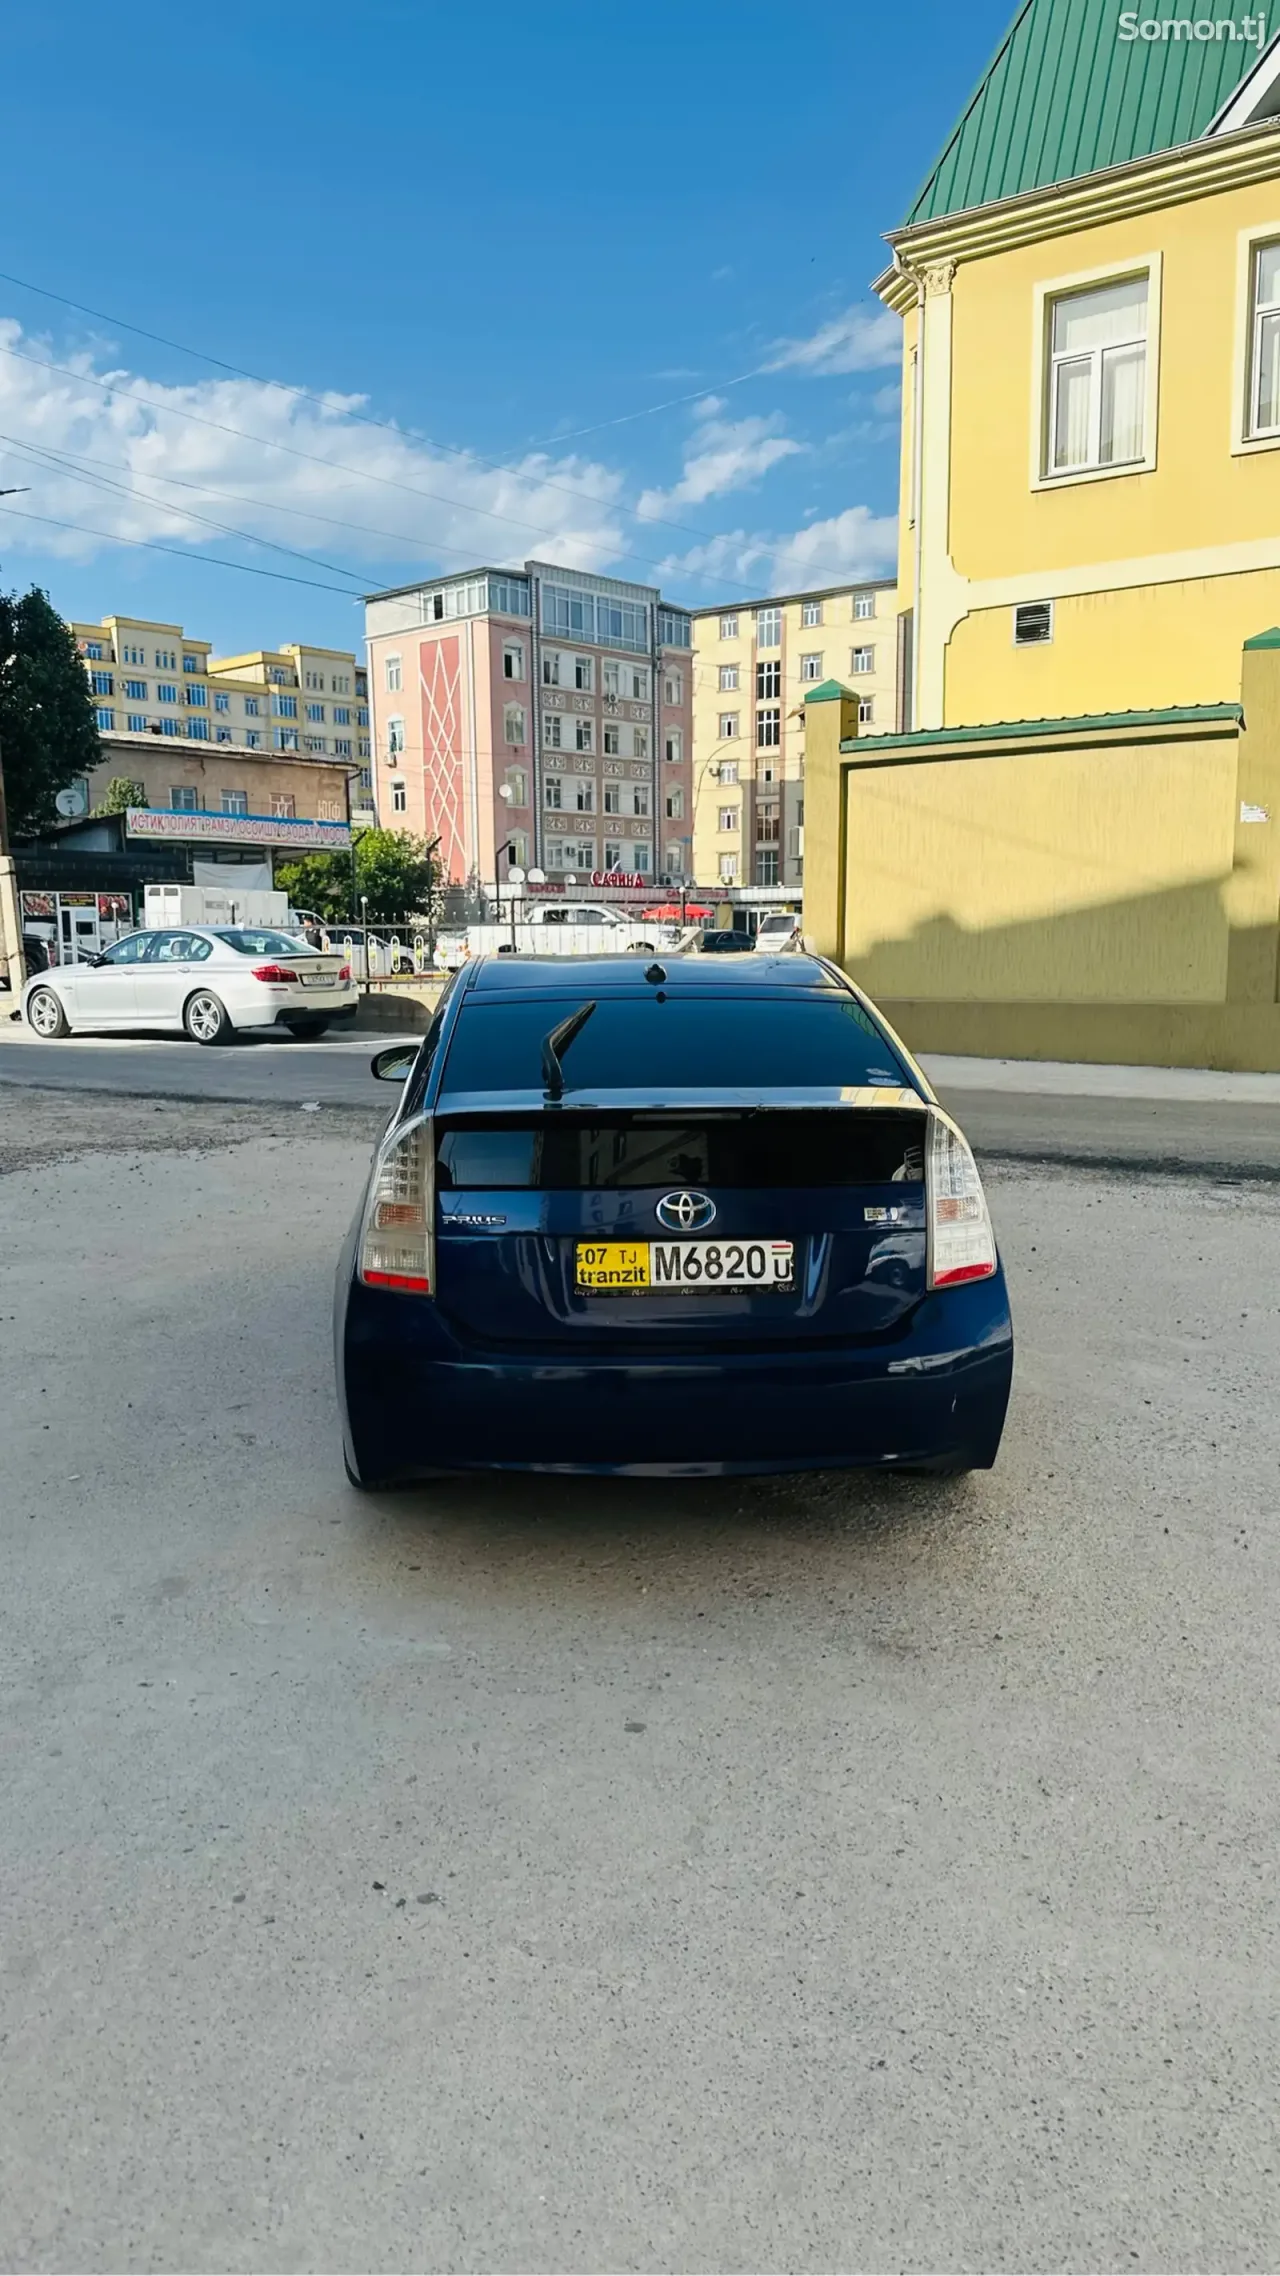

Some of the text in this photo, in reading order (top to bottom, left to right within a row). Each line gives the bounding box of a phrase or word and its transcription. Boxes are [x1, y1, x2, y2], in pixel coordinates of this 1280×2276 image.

[591, 870, 644, 888] САФИНА
[442, 1215, 506, 1225] PRIUS
[584, 1248, 637, 1265] 07 TJ
[655, 1245, 790, 1281] M6820 U
[579, 1266, 646, 1284] tranzit
